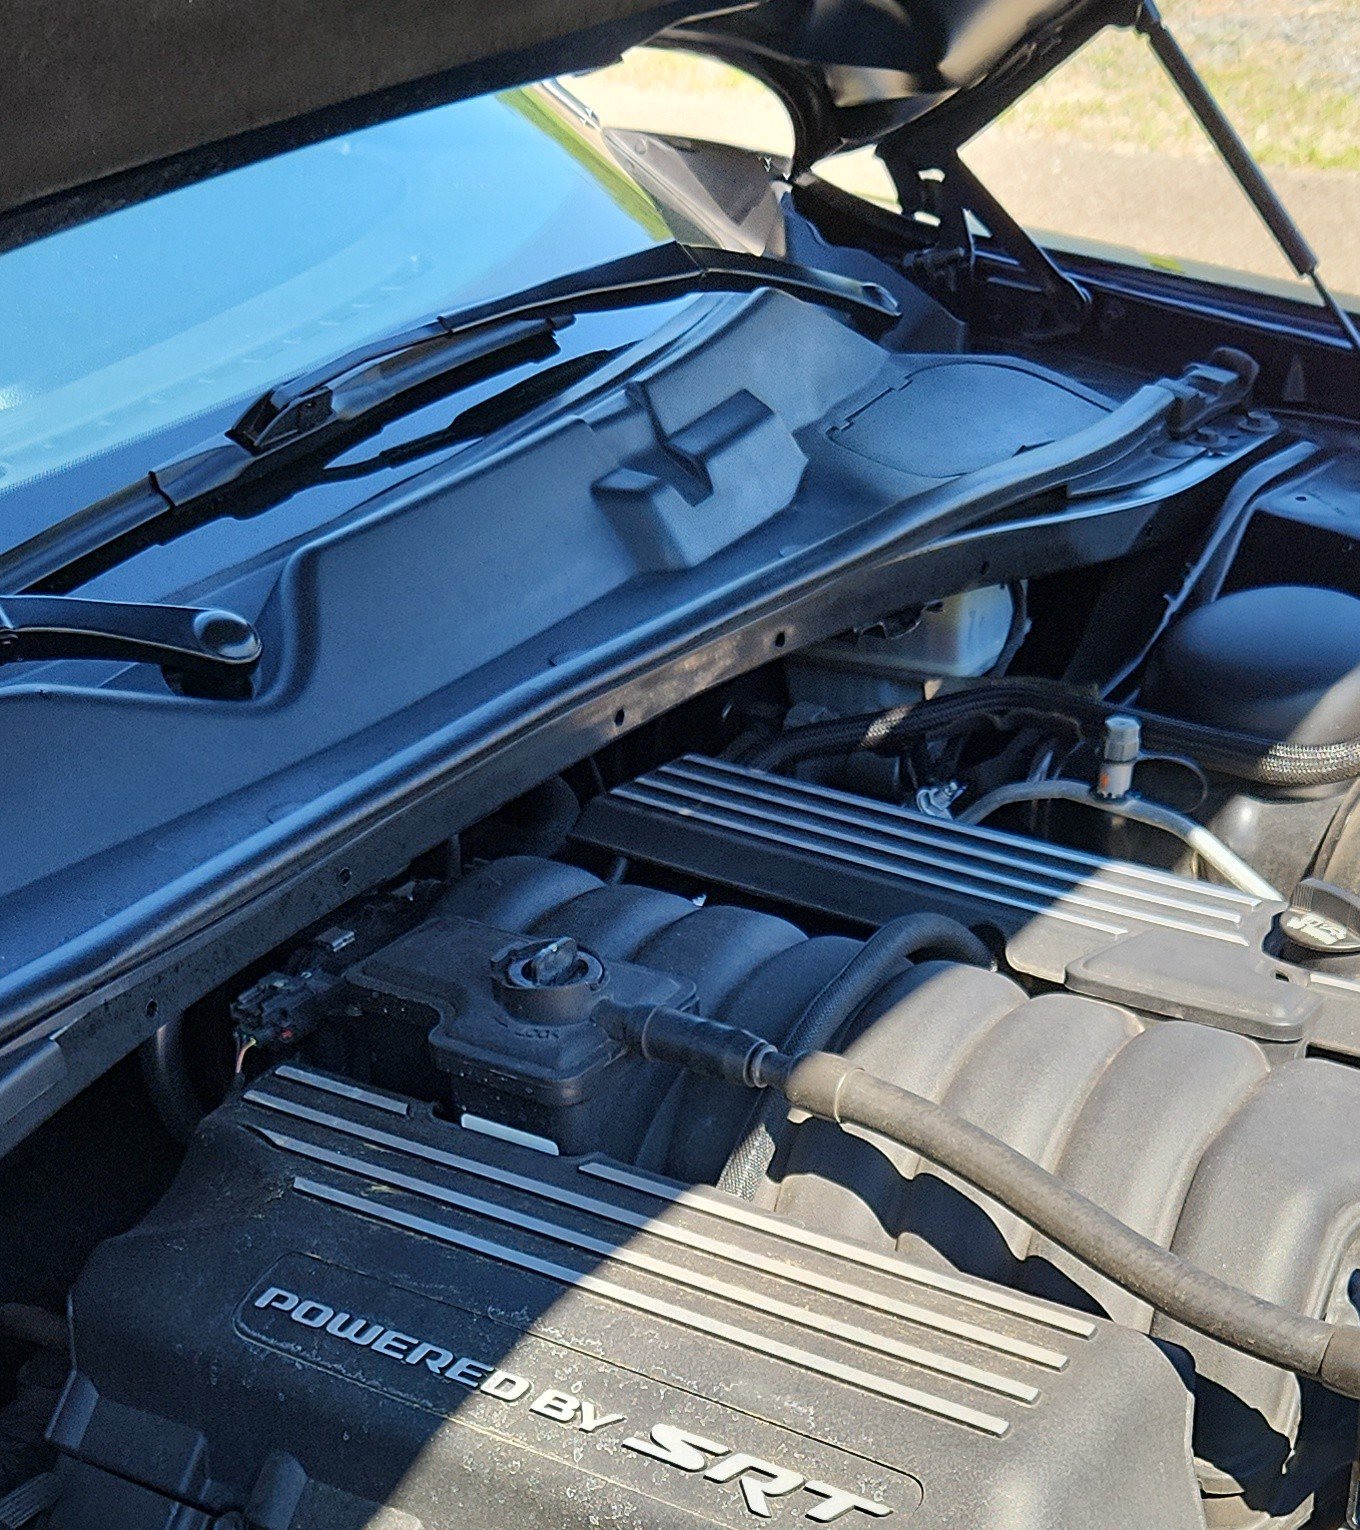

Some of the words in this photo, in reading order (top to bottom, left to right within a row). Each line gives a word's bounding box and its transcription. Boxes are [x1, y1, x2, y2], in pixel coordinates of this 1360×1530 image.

[253, 1285, 532, 1402] POWERED
[528, 1388, 627, 1434] BY
[621, 1422, 895, 1524] SRT
